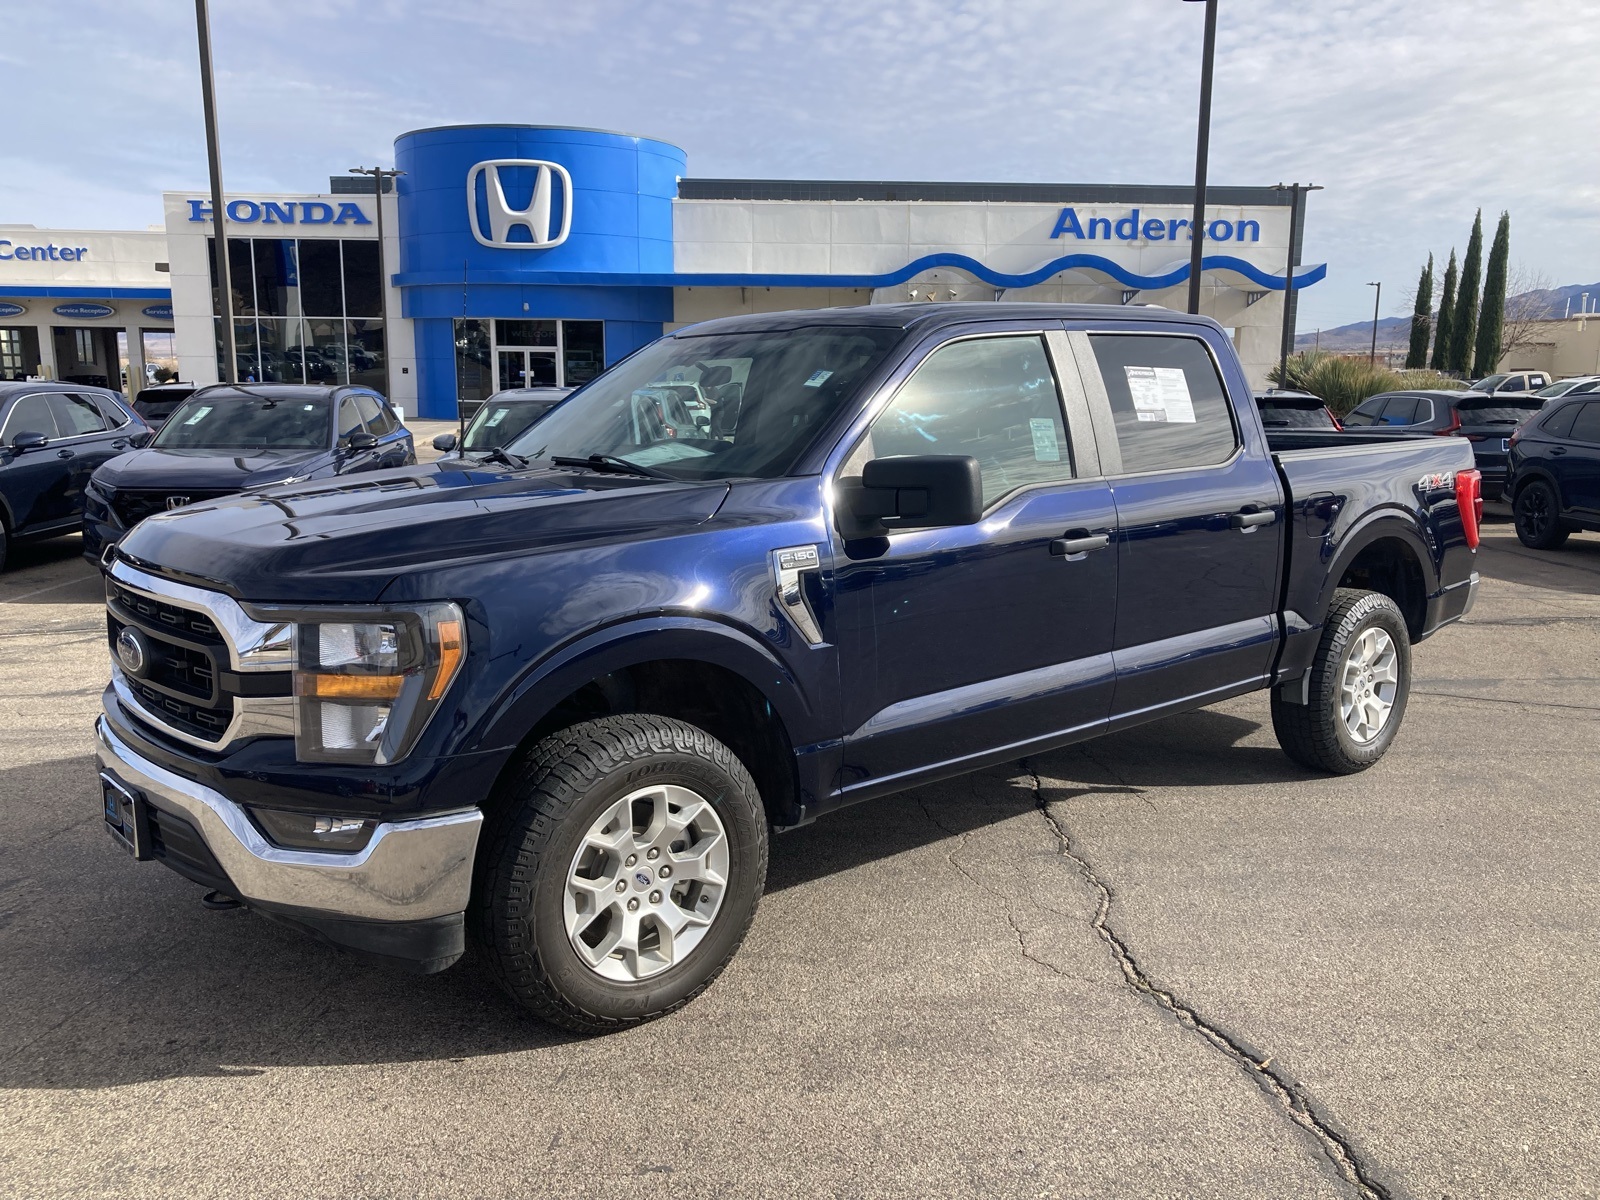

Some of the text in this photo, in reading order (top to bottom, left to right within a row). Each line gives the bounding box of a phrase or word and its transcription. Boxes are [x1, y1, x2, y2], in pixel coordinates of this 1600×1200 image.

[186, 199, 372, 225] HONDA
[0, 240, 87, 261] Center
[79, 307, 110, 315] Reception
[511, 330, 556, 338] WELCOM
[780, 550, 816, 562] F-150
[625, 760, 731, 797] TORMENTA
[636, 874, 650, 886] Ford
